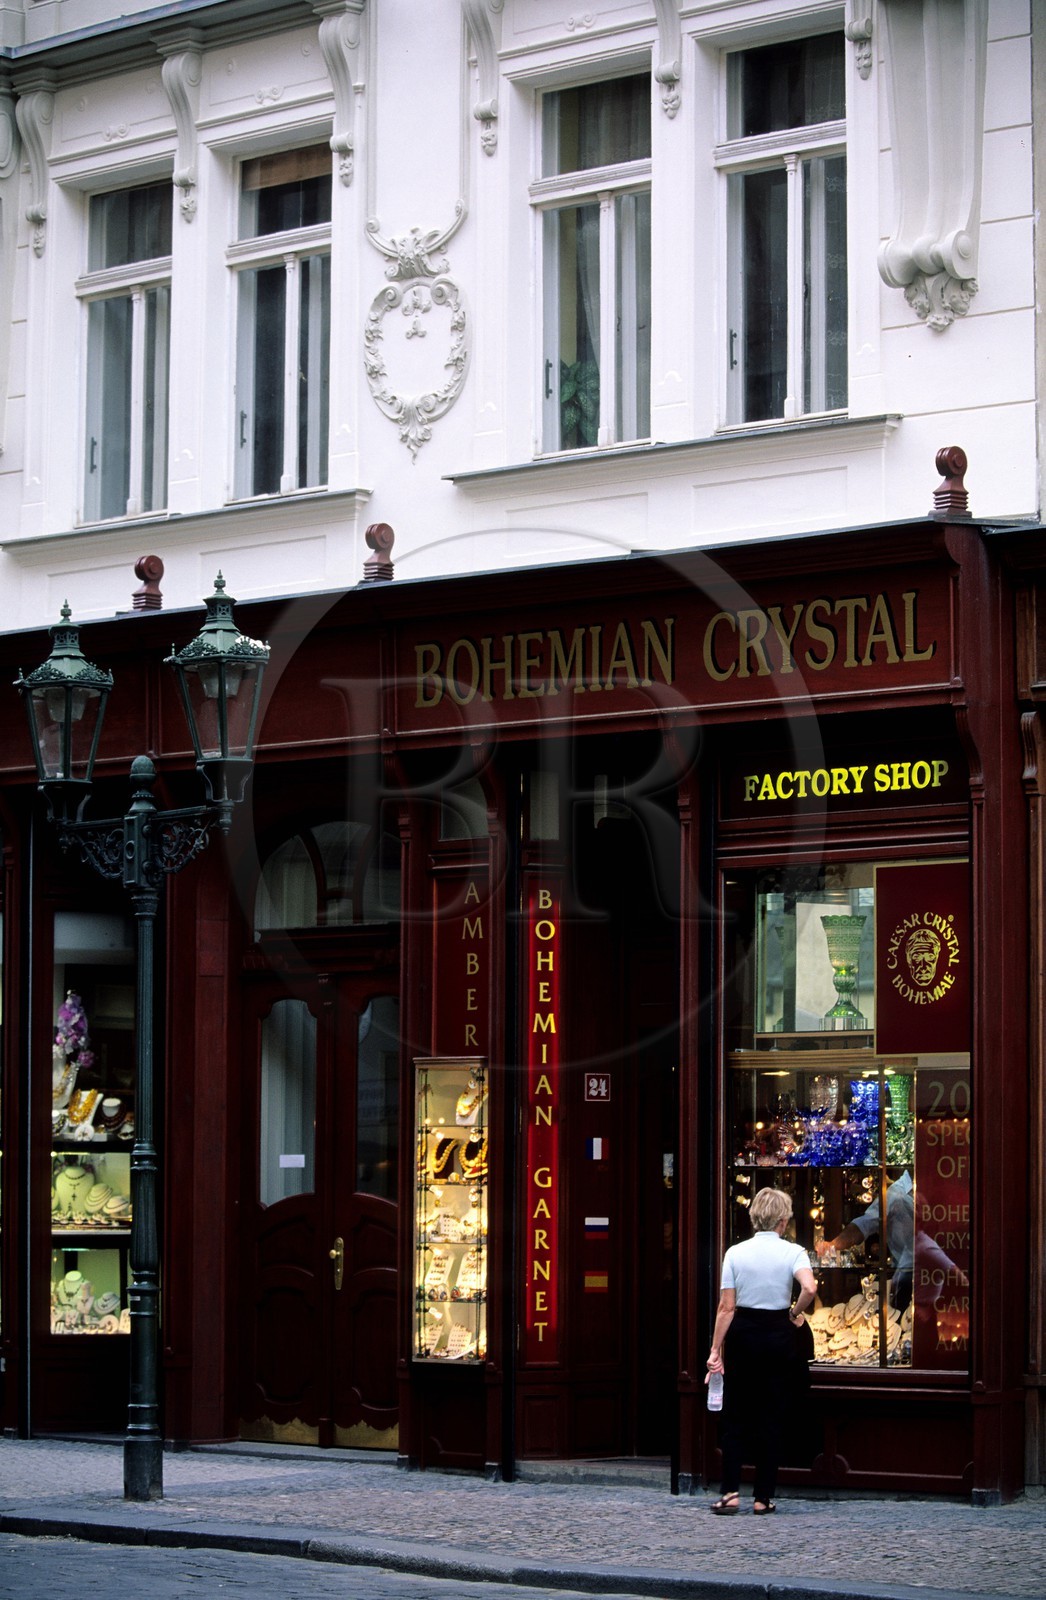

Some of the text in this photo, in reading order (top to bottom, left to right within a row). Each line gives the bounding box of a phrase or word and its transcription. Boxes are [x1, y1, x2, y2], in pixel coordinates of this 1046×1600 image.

[414, 591, 936, 709] BOHEMIAN CRYSTAL
[743, 759, 950, 802] FACTORY SHOP
[461, 881, 485, 1048] AMBER
[887, 912, 960, 969] CAESAR CRYSTAL
[588, 1077, 608, 1098] 24
[926, 1080, 970, 1117] 20
[532, 889, 557, 1344] BOHEMIAN GARNET
